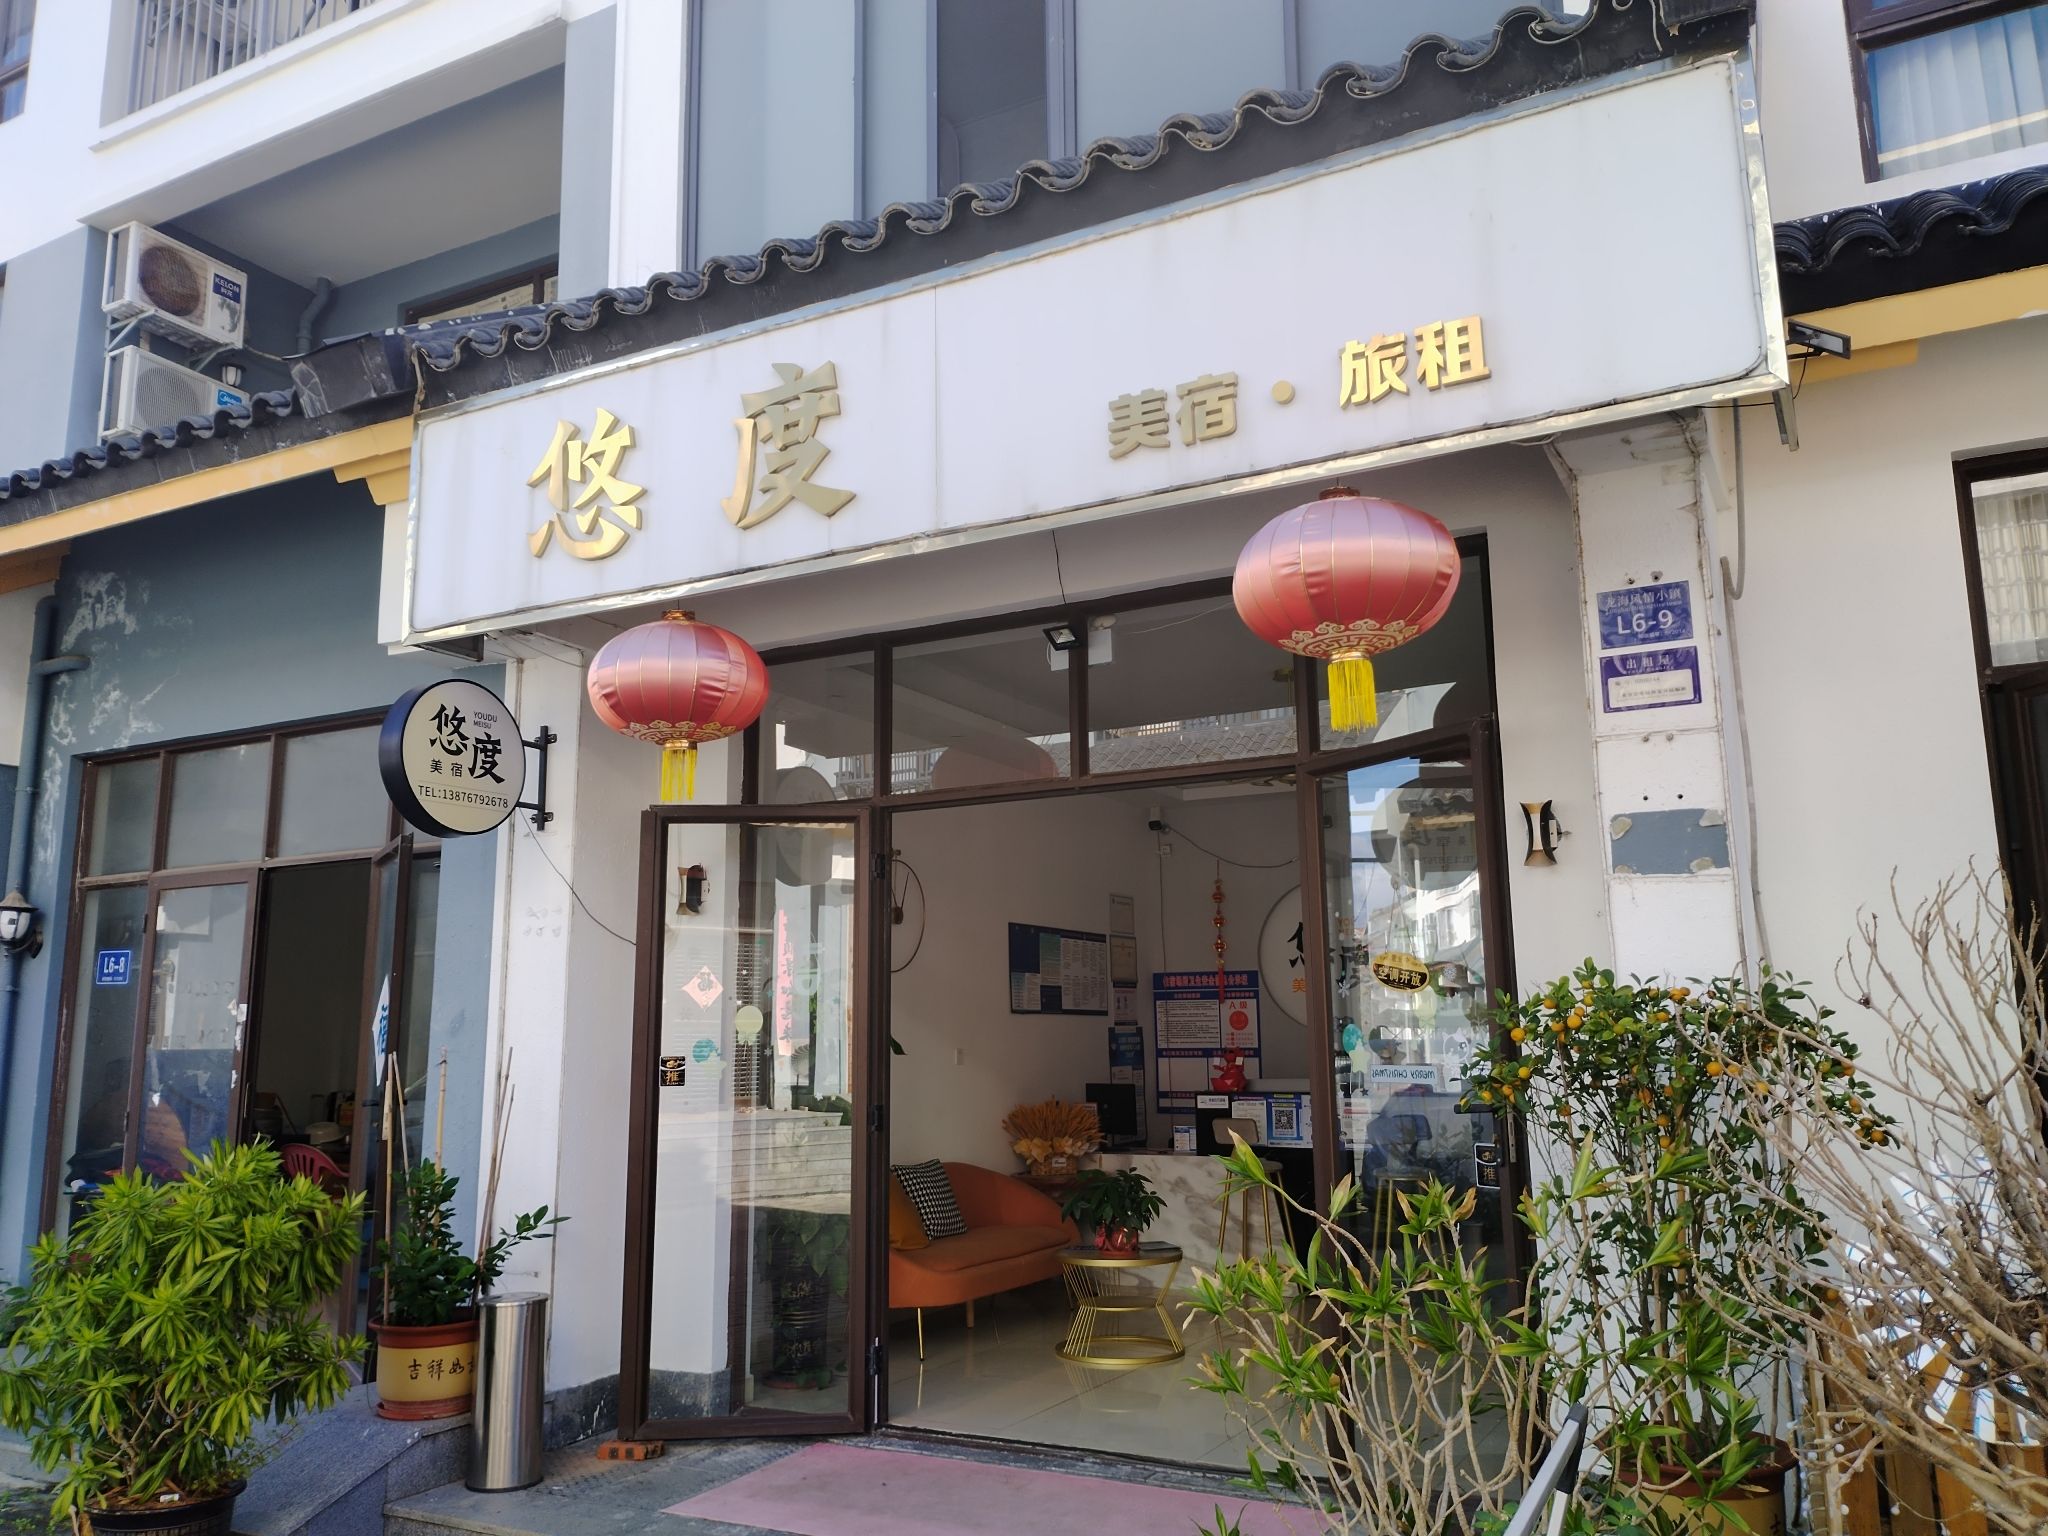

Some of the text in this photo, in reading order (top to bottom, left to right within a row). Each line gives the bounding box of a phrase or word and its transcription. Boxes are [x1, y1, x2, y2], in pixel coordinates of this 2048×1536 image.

[216, 277, 239, 292] KELON
[526, 360, 857, 561] 悠度
[1617, 609, 1674, 635] L6-9
[473, 711, 498, 723] YOUDU
[473, 720, 492, 730] MEISU
[429, 704, 506, 784] 悠度
[430, 758, 463, 777] 美宿
[417, 785, 509, 809] TEL:13876792678
[103, 957, 125, 973] L6-8
[1377, 966, 1422, 987] 空调开放
[664, 1070, 680, 1083] 推
